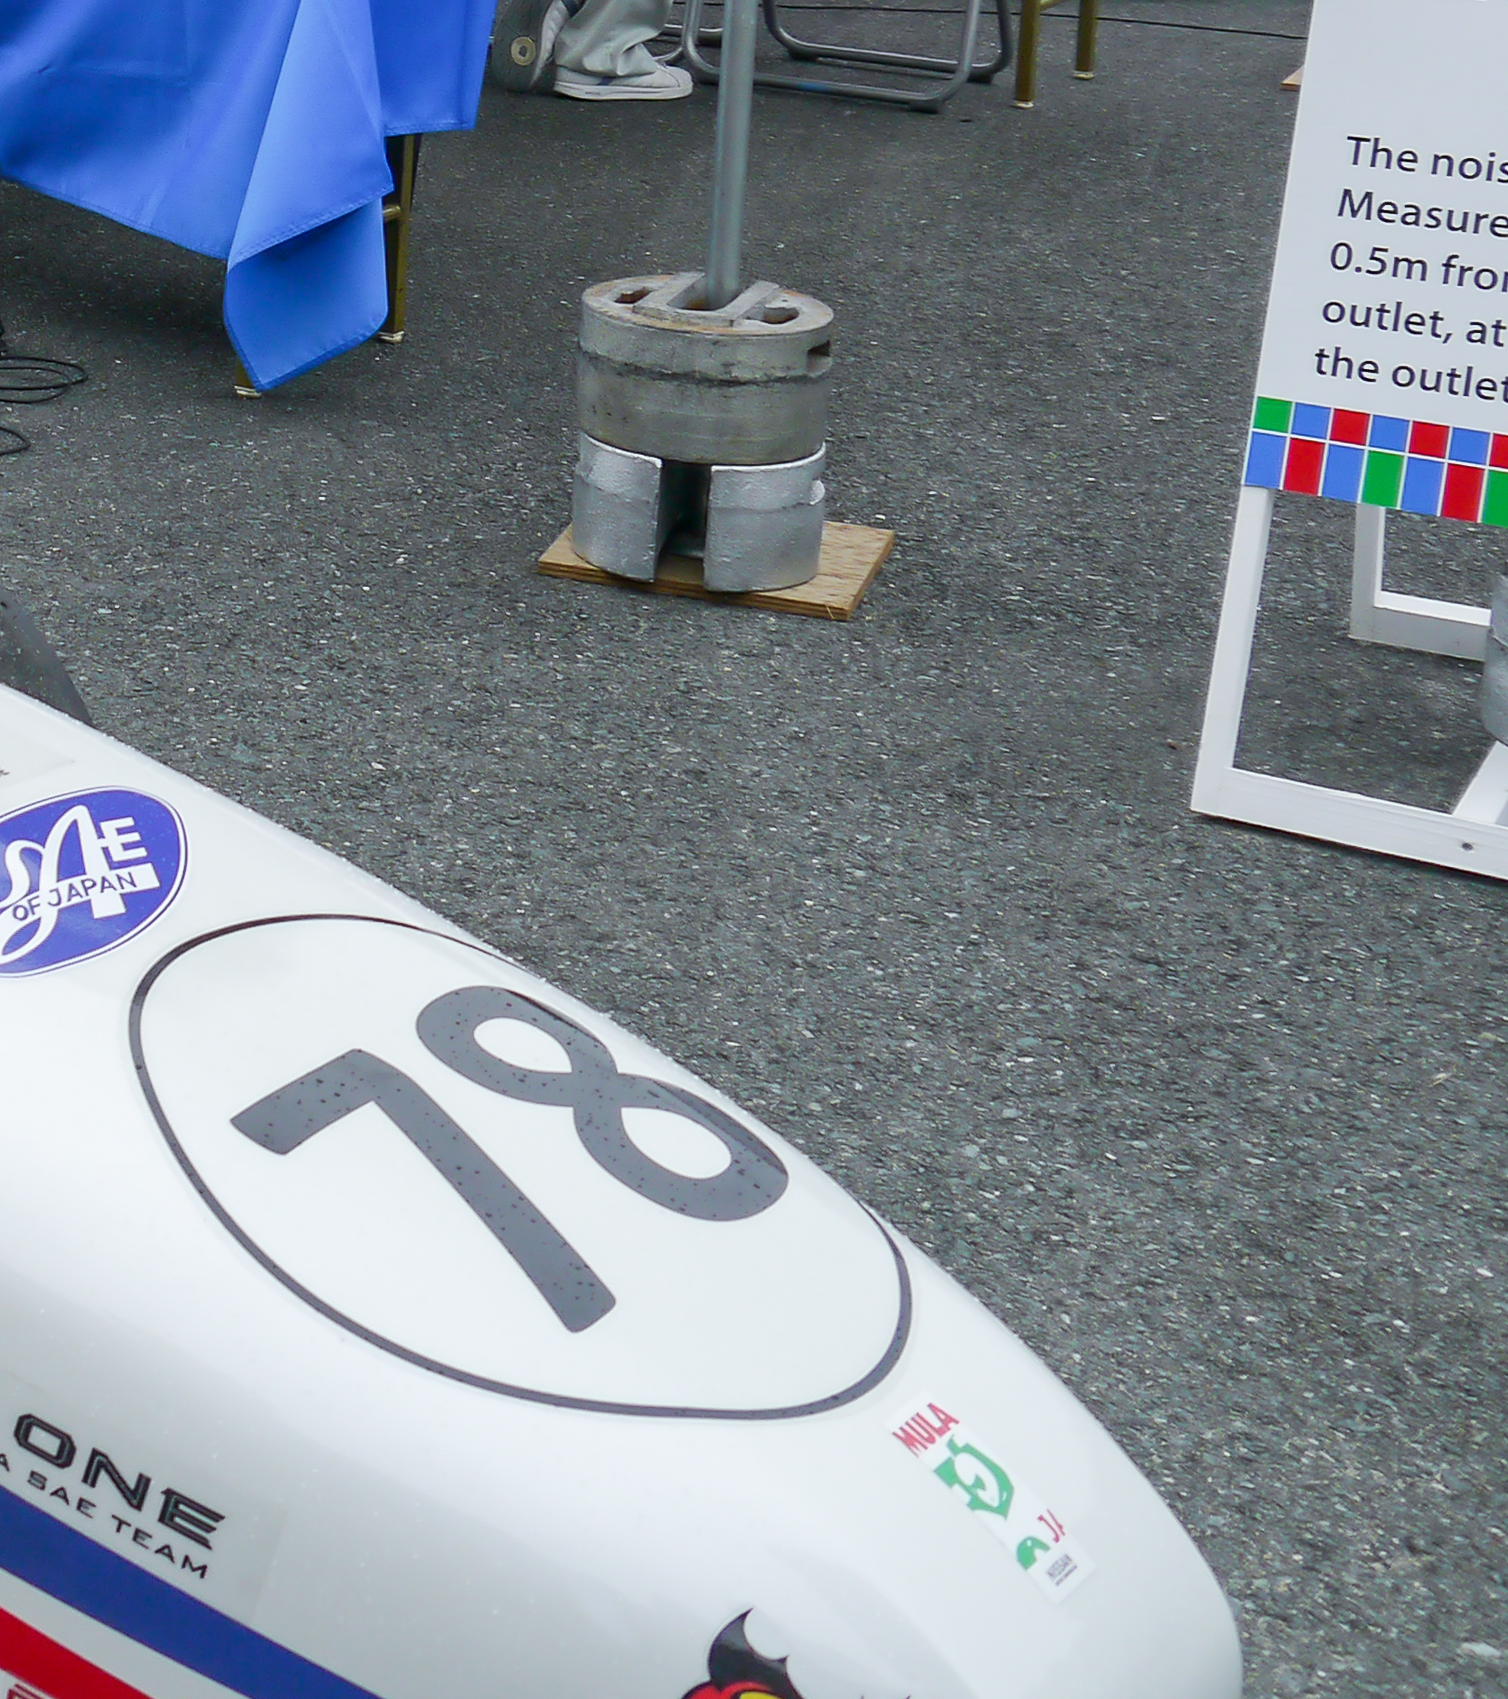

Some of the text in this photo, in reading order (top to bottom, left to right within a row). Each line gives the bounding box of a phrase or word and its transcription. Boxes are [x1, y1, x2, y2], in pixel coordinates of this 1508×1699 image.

[1347, 135, 1418, 172] The
[1329, 242, 1508, 293] 0.5m fro
[1322, 302, 1507, 348] outlet, at
[1315, 347, 1379, 382] the
[11, 870, 137, 922] OF JAPAN
[230, 986, 789, 1332] 78
[13, 1412, 228, 1552] ONE
[27, 1467, 97, 1522] SAE
[108, 1517, 210, 1580] TEAM
